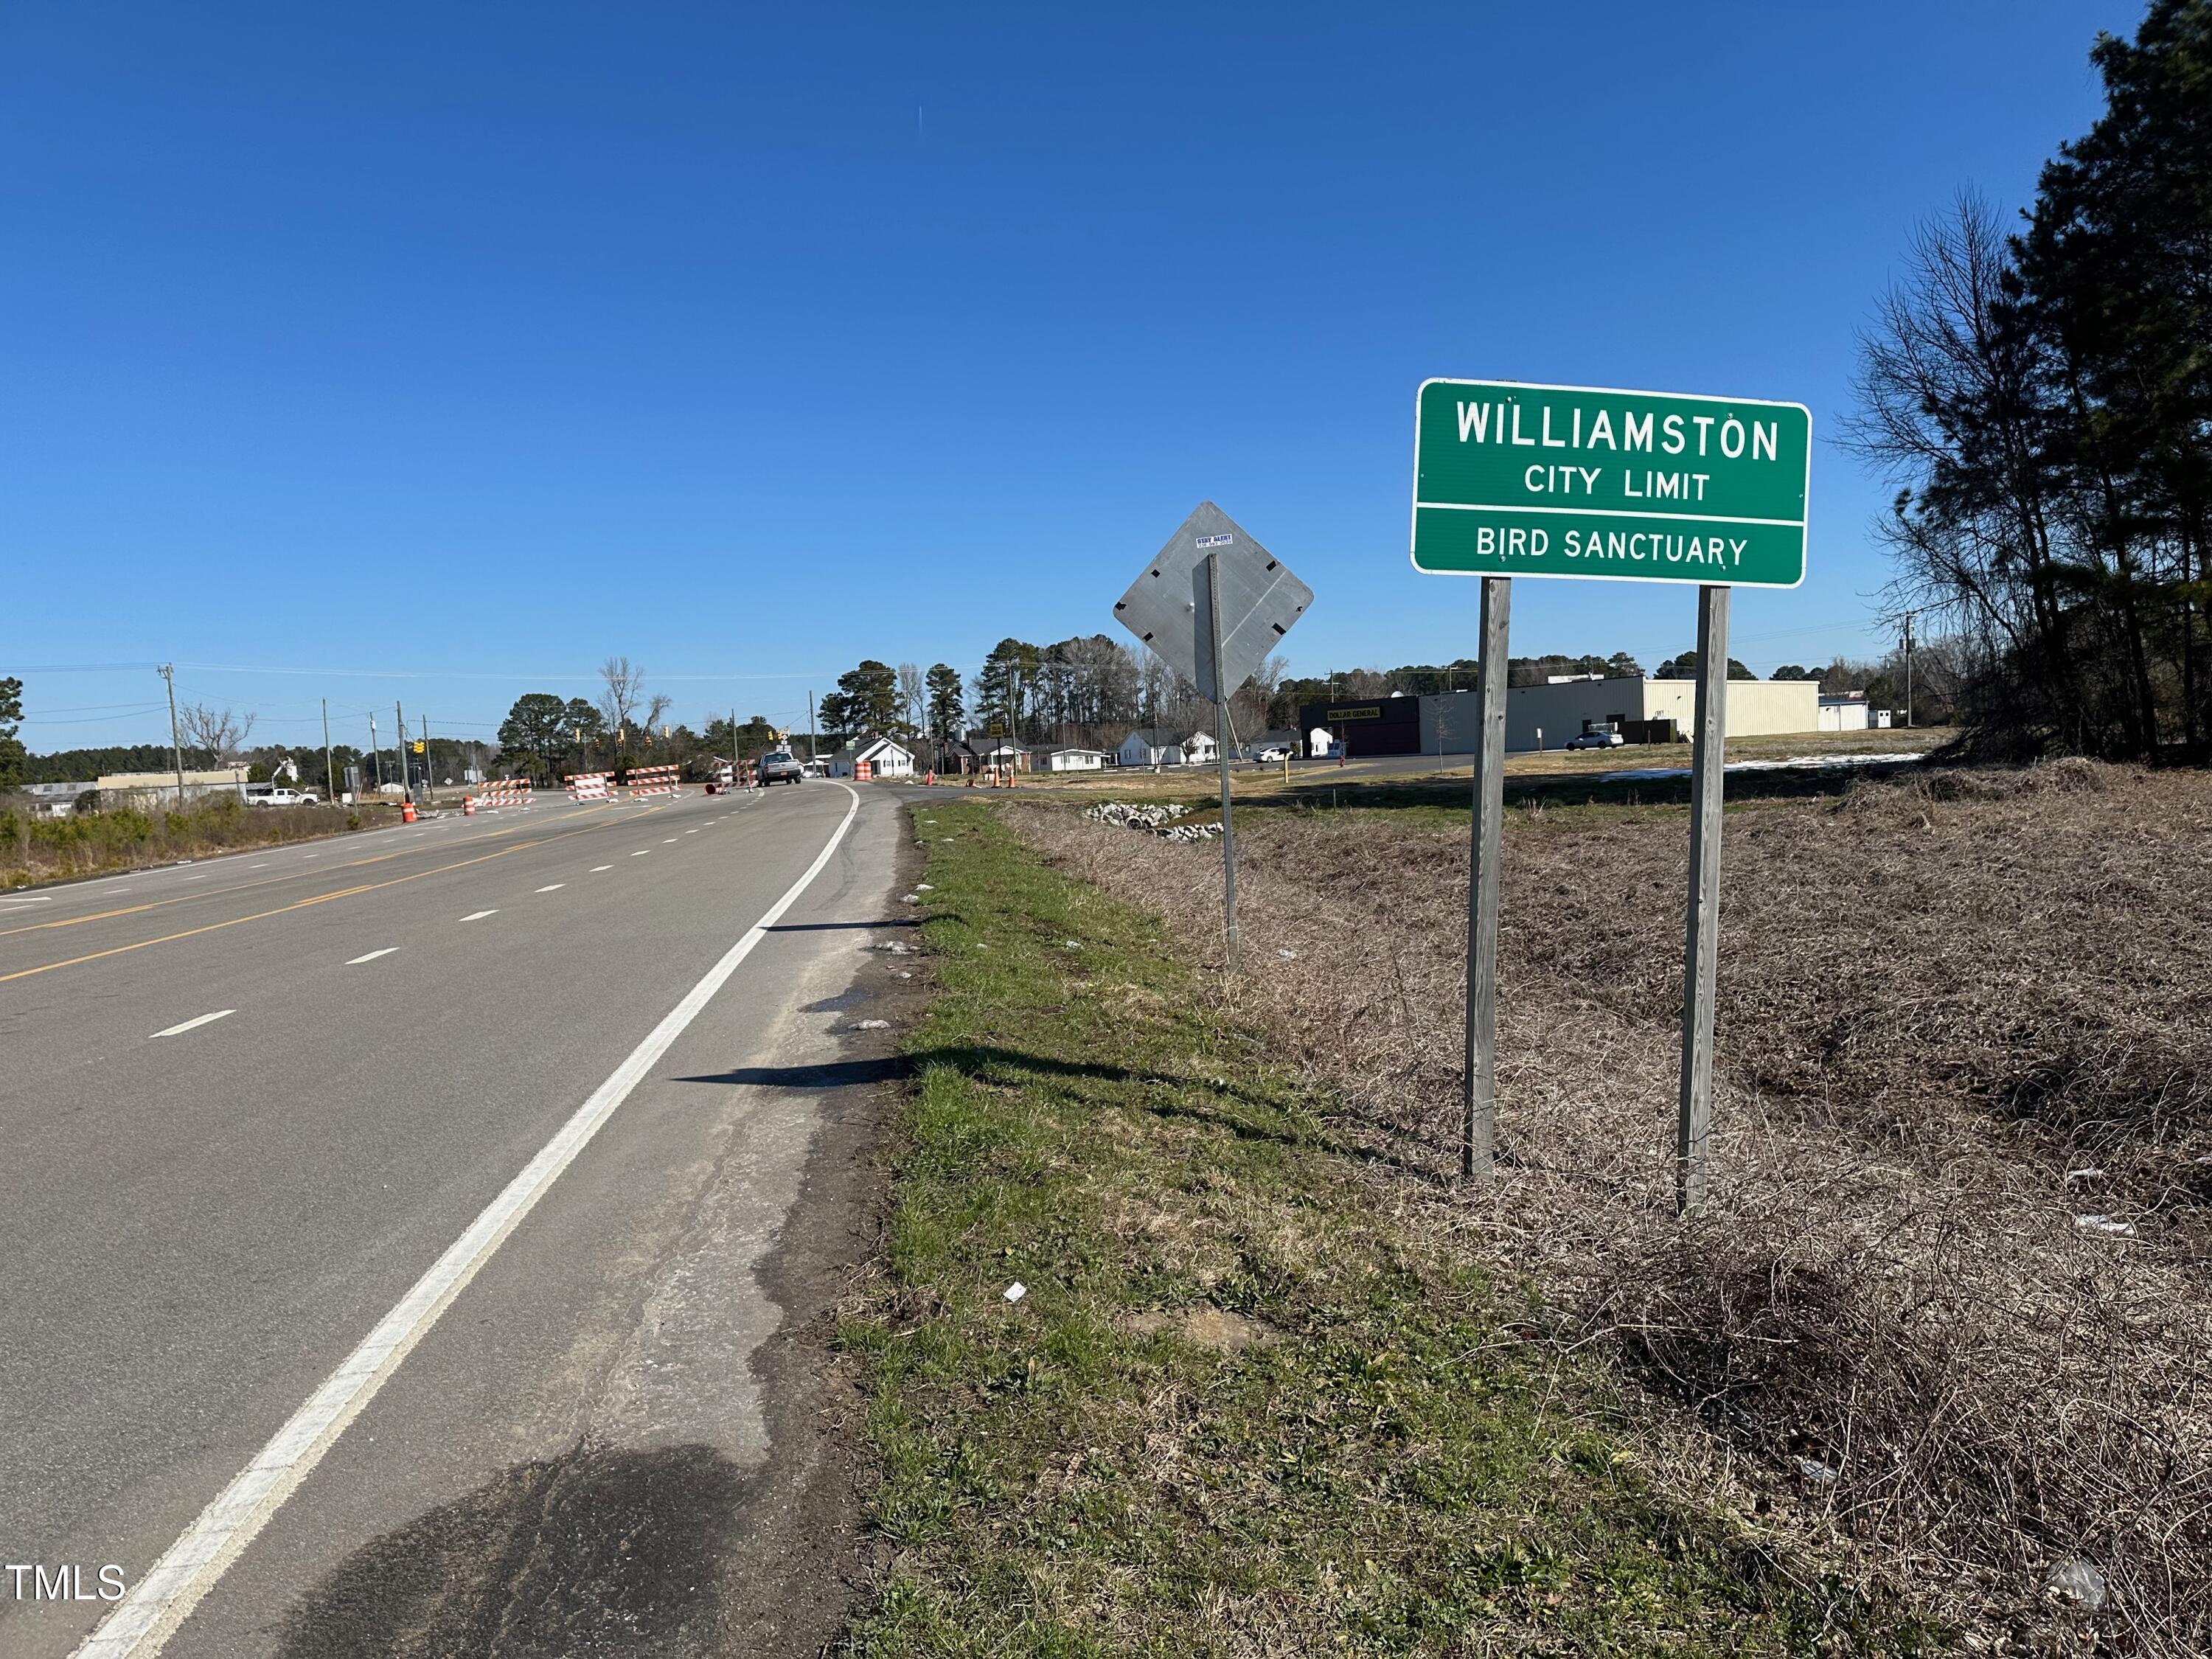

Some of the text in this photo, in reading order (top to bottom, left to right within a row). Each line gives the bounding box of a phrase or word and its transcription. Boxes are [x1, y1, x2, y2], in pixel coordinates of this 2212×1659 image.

[1457, 401, 1778, 461] WILLIAMSTON
[1524, 465, 1710, 501] CITY LIMIT
[1477, 527, 1747, 566] BIRD SANCTUARY
[1329, 709, 1379, 719] DOLLAR GENERAL
